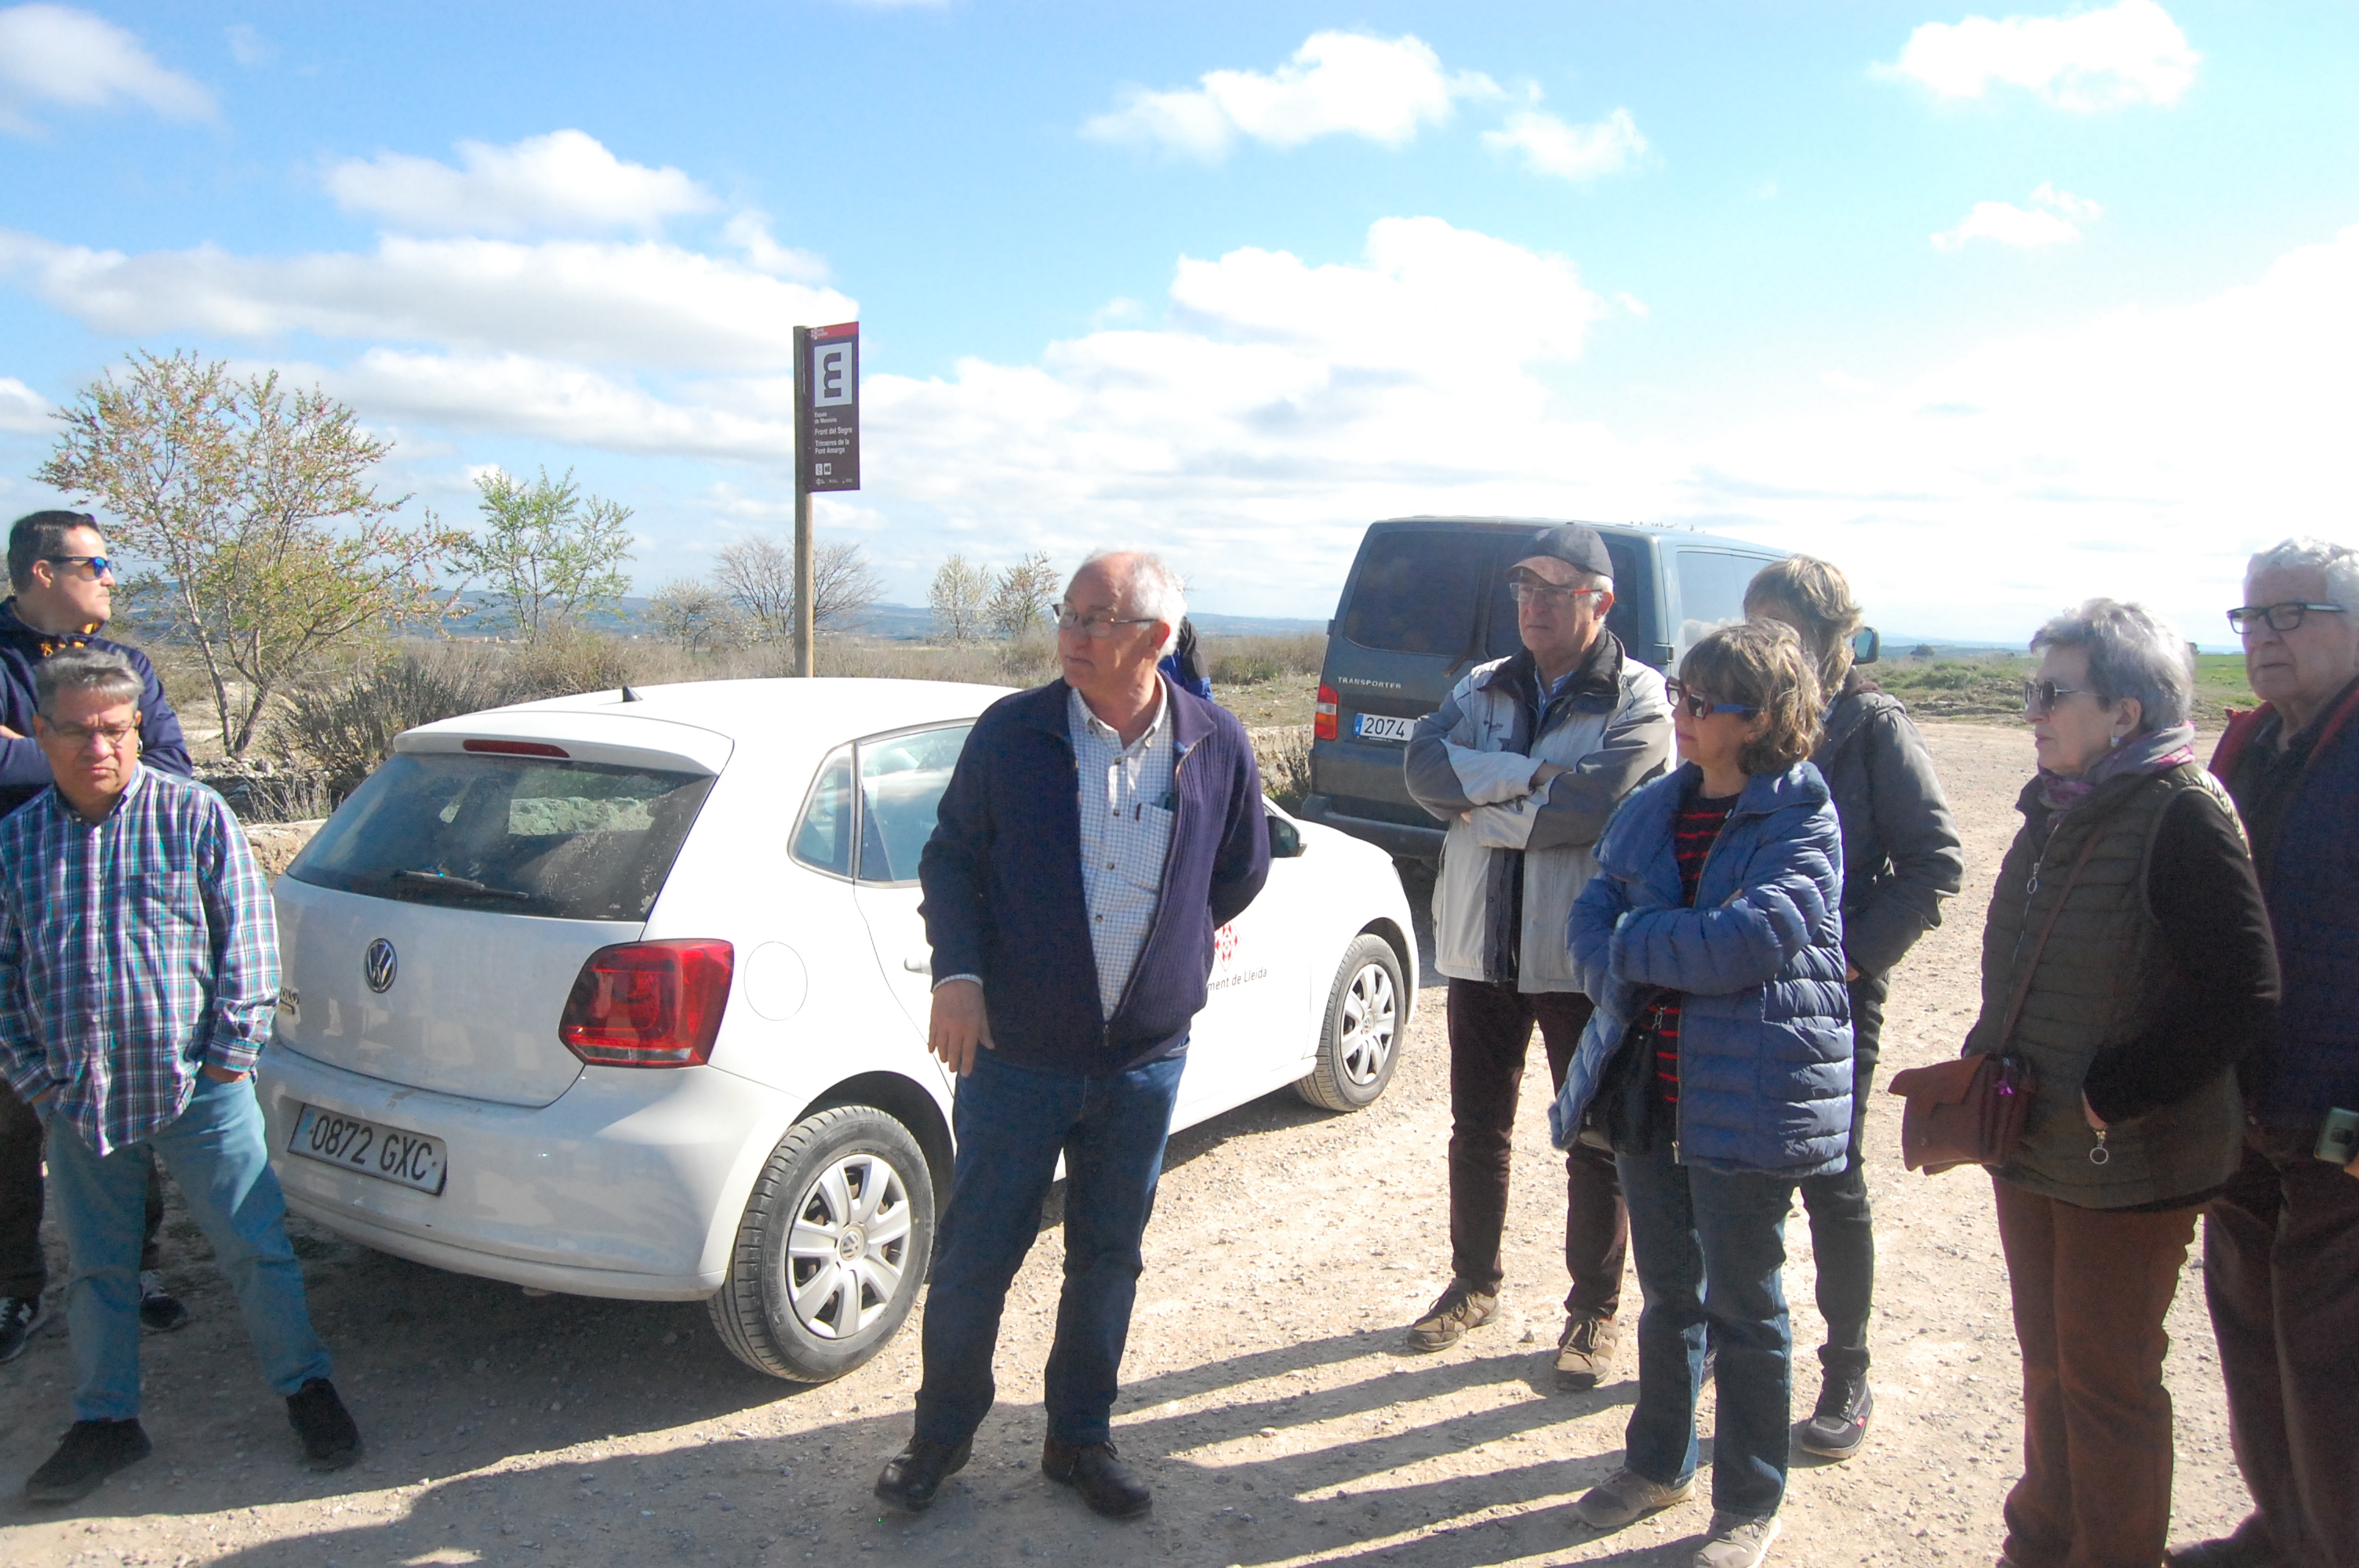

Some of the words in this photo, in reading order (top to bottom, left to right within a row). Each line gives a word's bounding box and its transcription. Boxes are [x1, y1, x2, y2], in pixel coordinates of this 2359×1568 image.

[828, 426, 837, 435] del
[837, 426, 853, 436] Segre
[826, 446, 845, 455] Amarga
[1338, 676, 1402, 690] TRANSPORTER
[1364, 717, 1405, 738] 2074
[1207, 977, 1230, 992] ment
[1231, 973, 1241, 986] de
[1244, 967, 1267, 983] Lleida
[279, 986, 300, 1004] OLO
[311, 1114, 373, 1165] 0872
[379, 1133, 433, 1181] GXC
